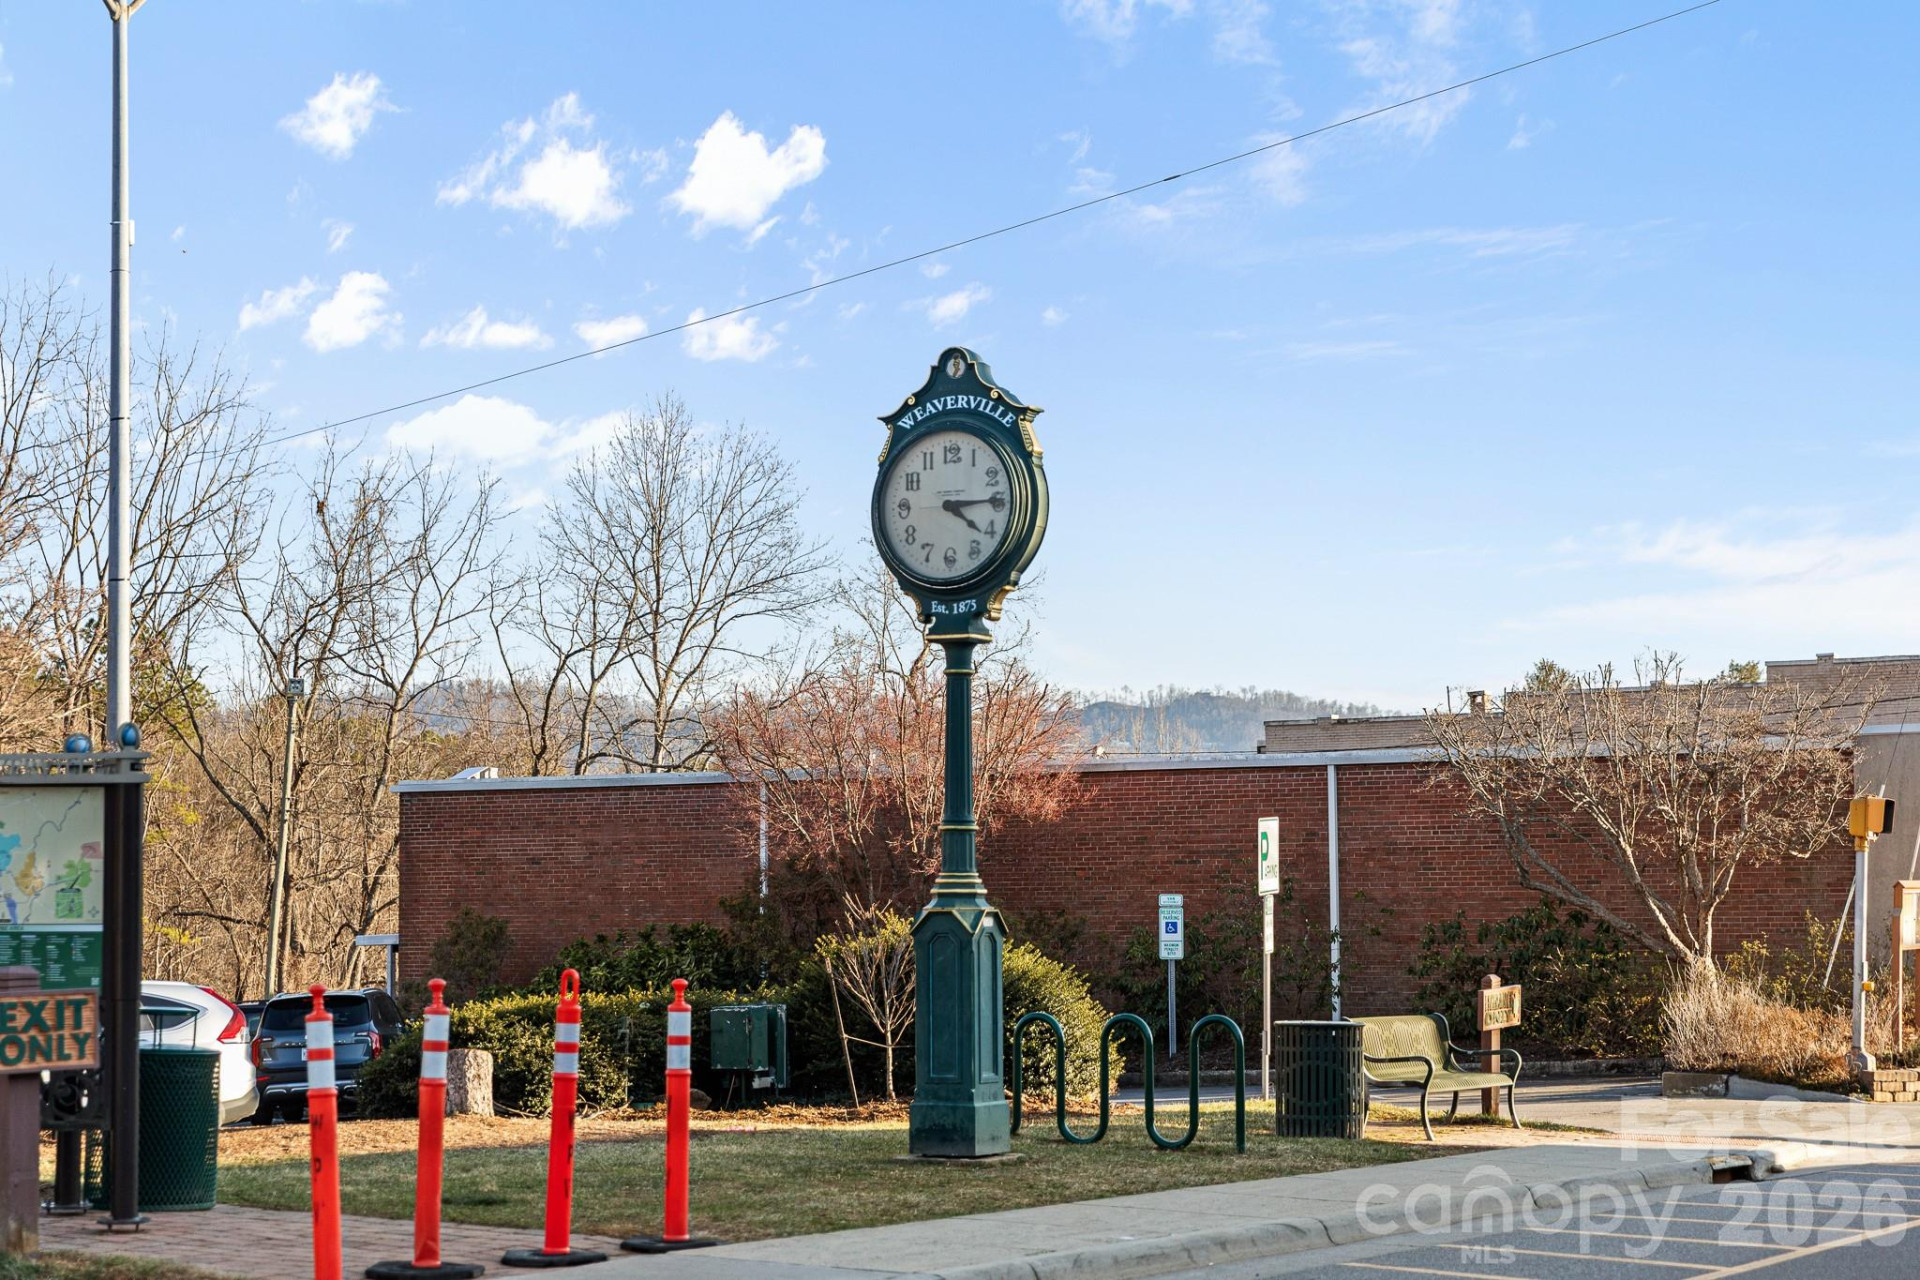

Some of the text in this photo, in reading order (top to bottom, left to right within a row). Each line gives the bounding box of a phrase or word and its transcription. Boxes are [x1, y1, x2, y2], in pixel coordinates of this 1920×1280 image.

[897, 394, 1017, 431] WEAVERVILLE
[923, 451, 934, 471] 11
[943, 443, 962, 465] 12
[971, 448, 977, 468] 1
[905, 471, 920, 492] 10
[985, 466, 999, 487] 2
[898, 497, 911, 520] 9
[904, 524, 917, 546] 8
[984, 519, 997, 540] 4
[921, 542, 935, 563] 7
[943, 546, 957, 569] 6
[968, 539, 981, 561] 5
[931, 599, 977, 615] Est. 1875
[0, 998, 89, 1033] EXIT
[0, 1032, 91, 1066] ONLY
